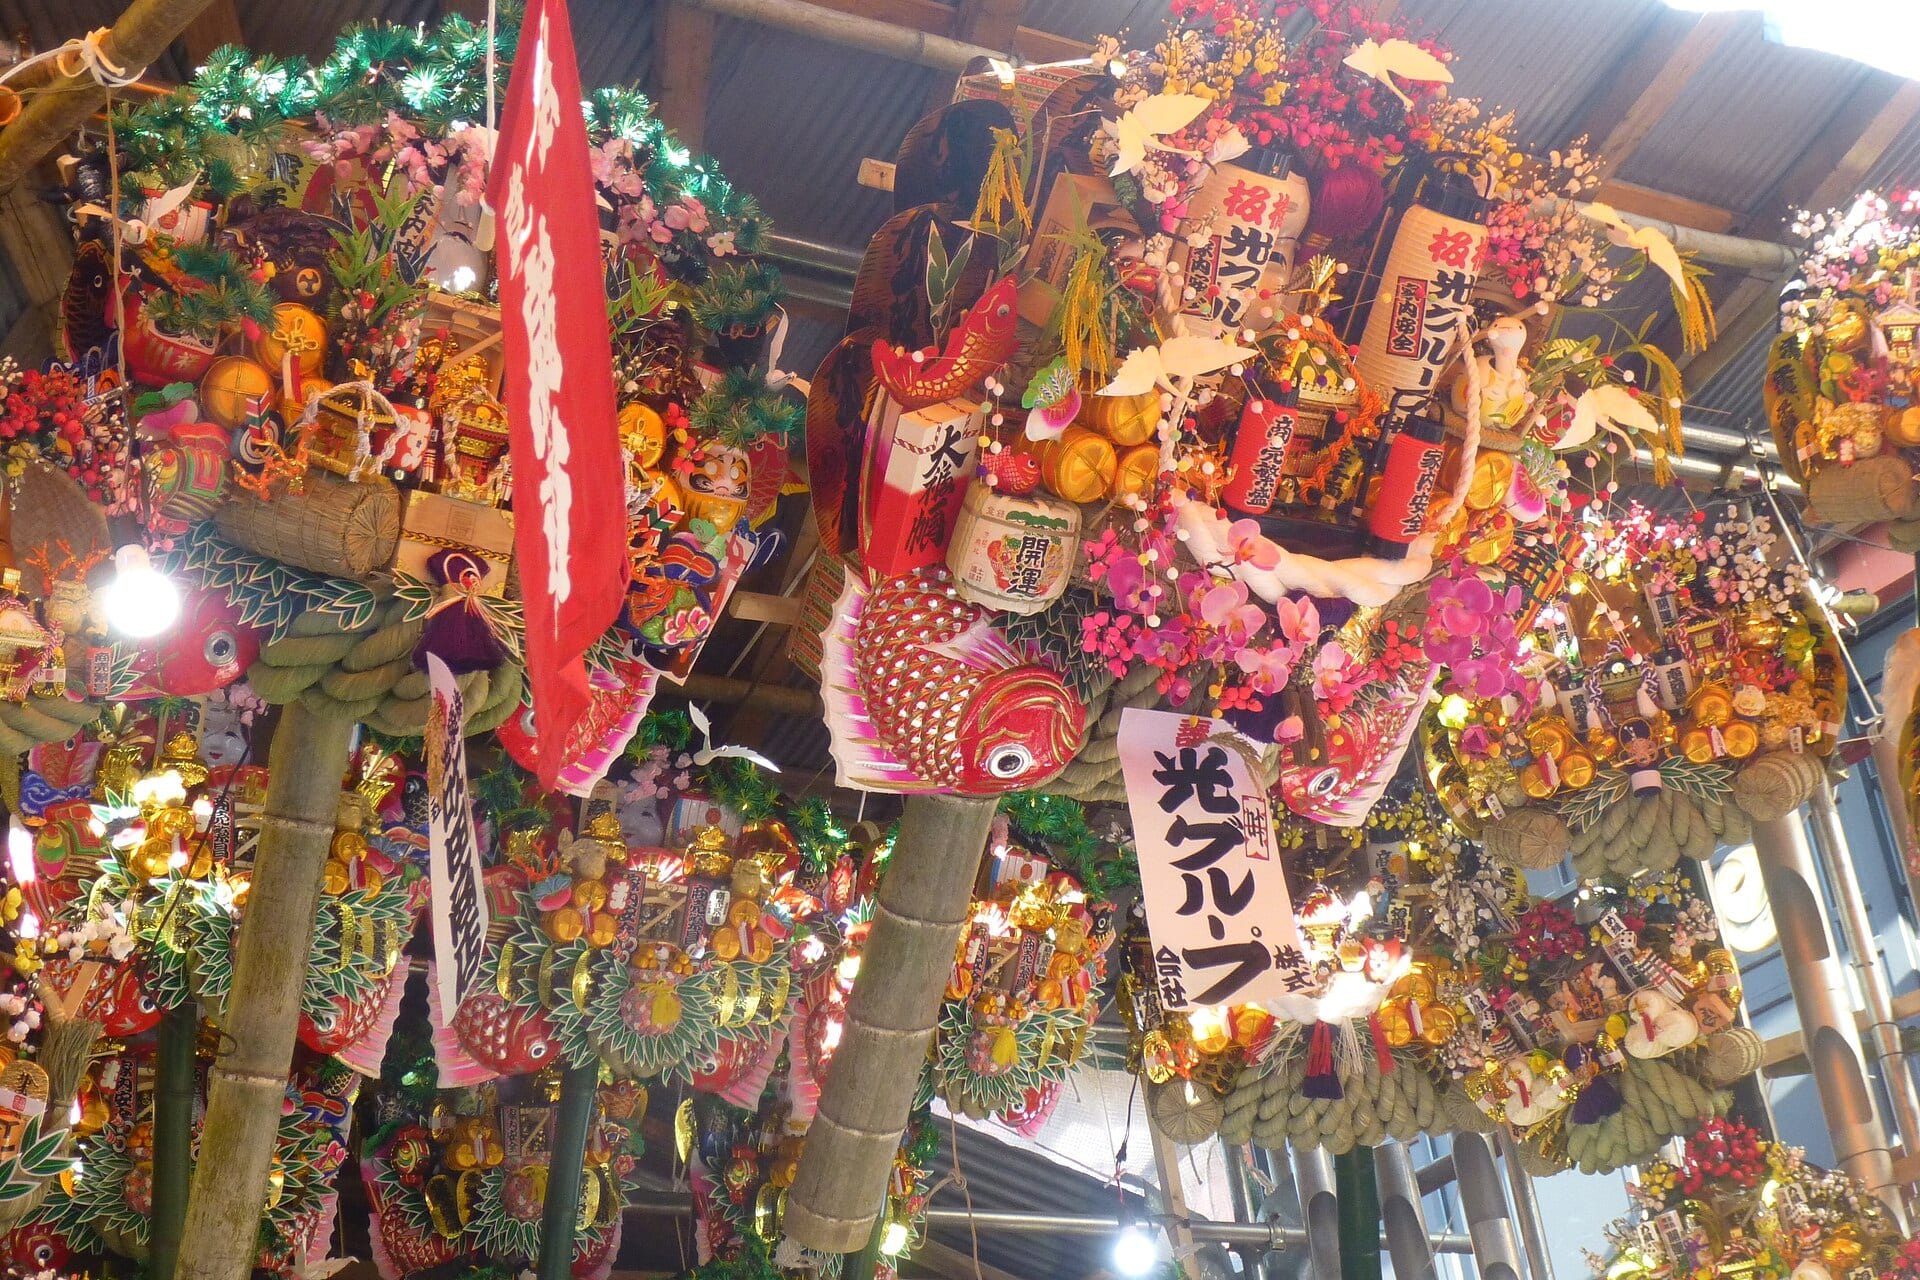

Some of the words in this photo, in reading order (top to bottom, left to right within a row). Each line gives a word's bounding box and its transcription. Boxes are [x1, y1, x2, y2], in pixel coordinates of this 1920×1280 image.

[1391, 282, 1420, 352] 家内安全
[904, 424, 970, 557] 大福帳
[1400, 448, 1444, 535] 家内安全
[1006, 535, 1050, 598] 開運
[1152, 746, 1272, 1006] 光グループ
[1155, 944, 1189, 1009] 会社
[1272, 943, 1318, 993] 株式
